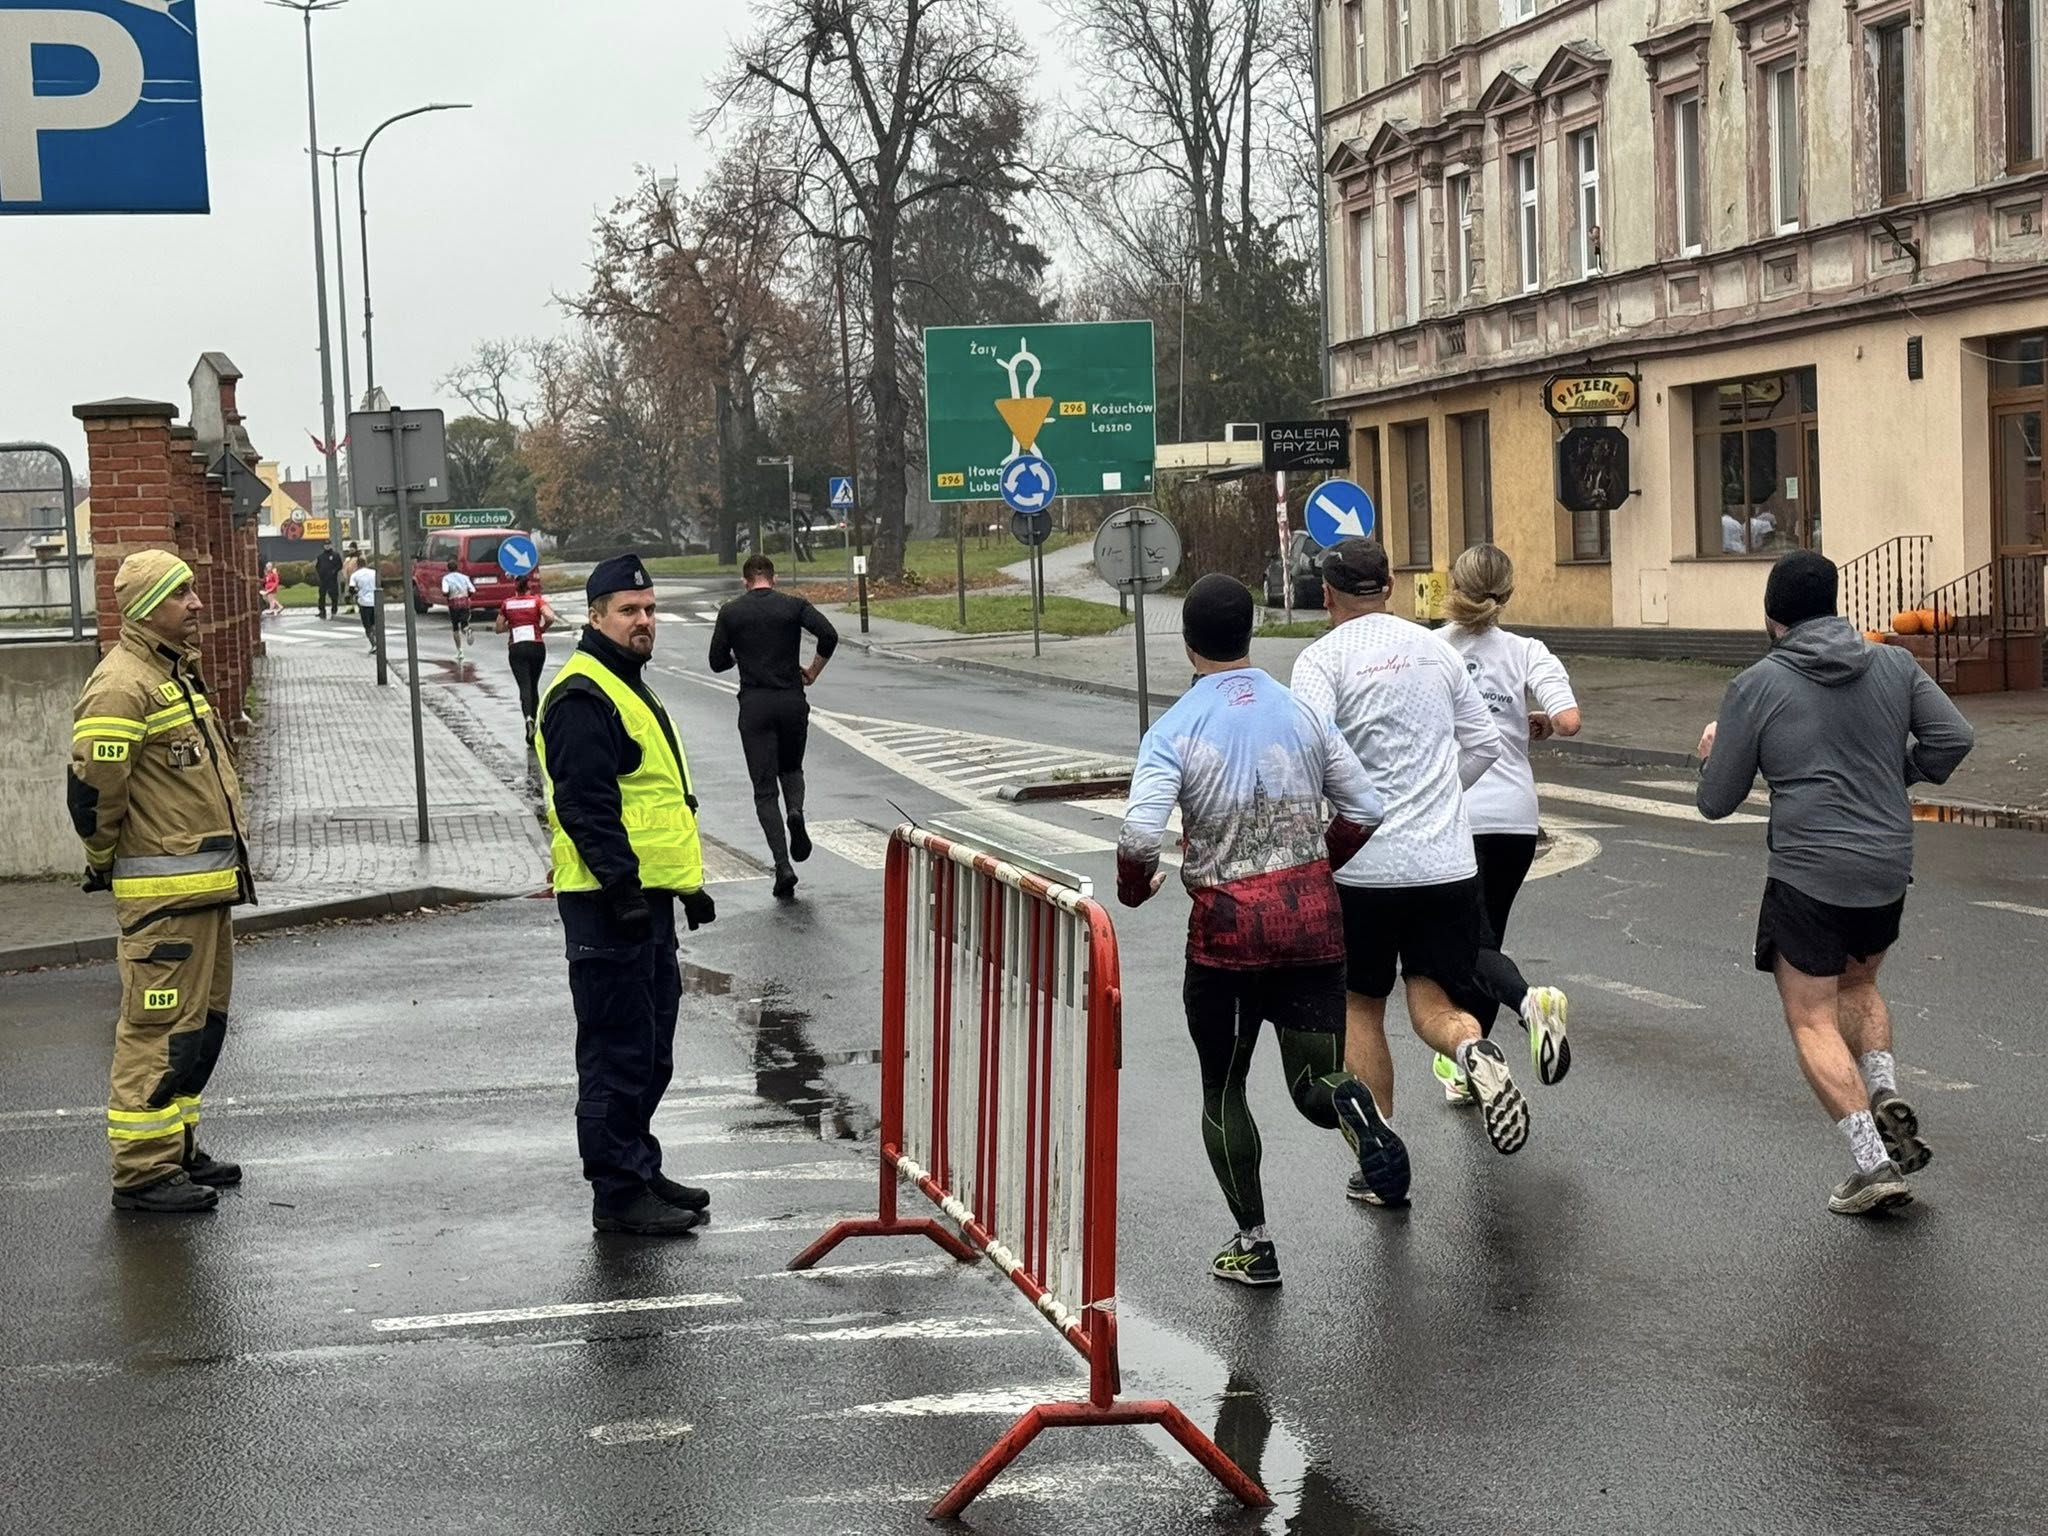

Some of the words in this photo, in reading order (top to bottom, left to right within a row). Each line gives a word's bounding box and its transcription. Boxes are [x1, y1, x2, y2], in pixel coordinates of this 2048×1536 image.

[0, 9, 144, 201] P
[1063, 403, 1083, 414] 296
[1092, 401, 1153, 414] Kożuchów
[1091, 421, 1132, 433] Leszno
[1271, 428, 1340, 440] GALERIA
[1273, 440, 1340, 452] FRYZUR
[941, 475, 961, 486] 296
[969, 481, 1000, 492] Luba
[428, 514, 447, 524] 296
[454, 512, 508, 524] Kożuchów
[97, 744, 124, 758] OSP
[149, 993, 175, 1006] OSP
